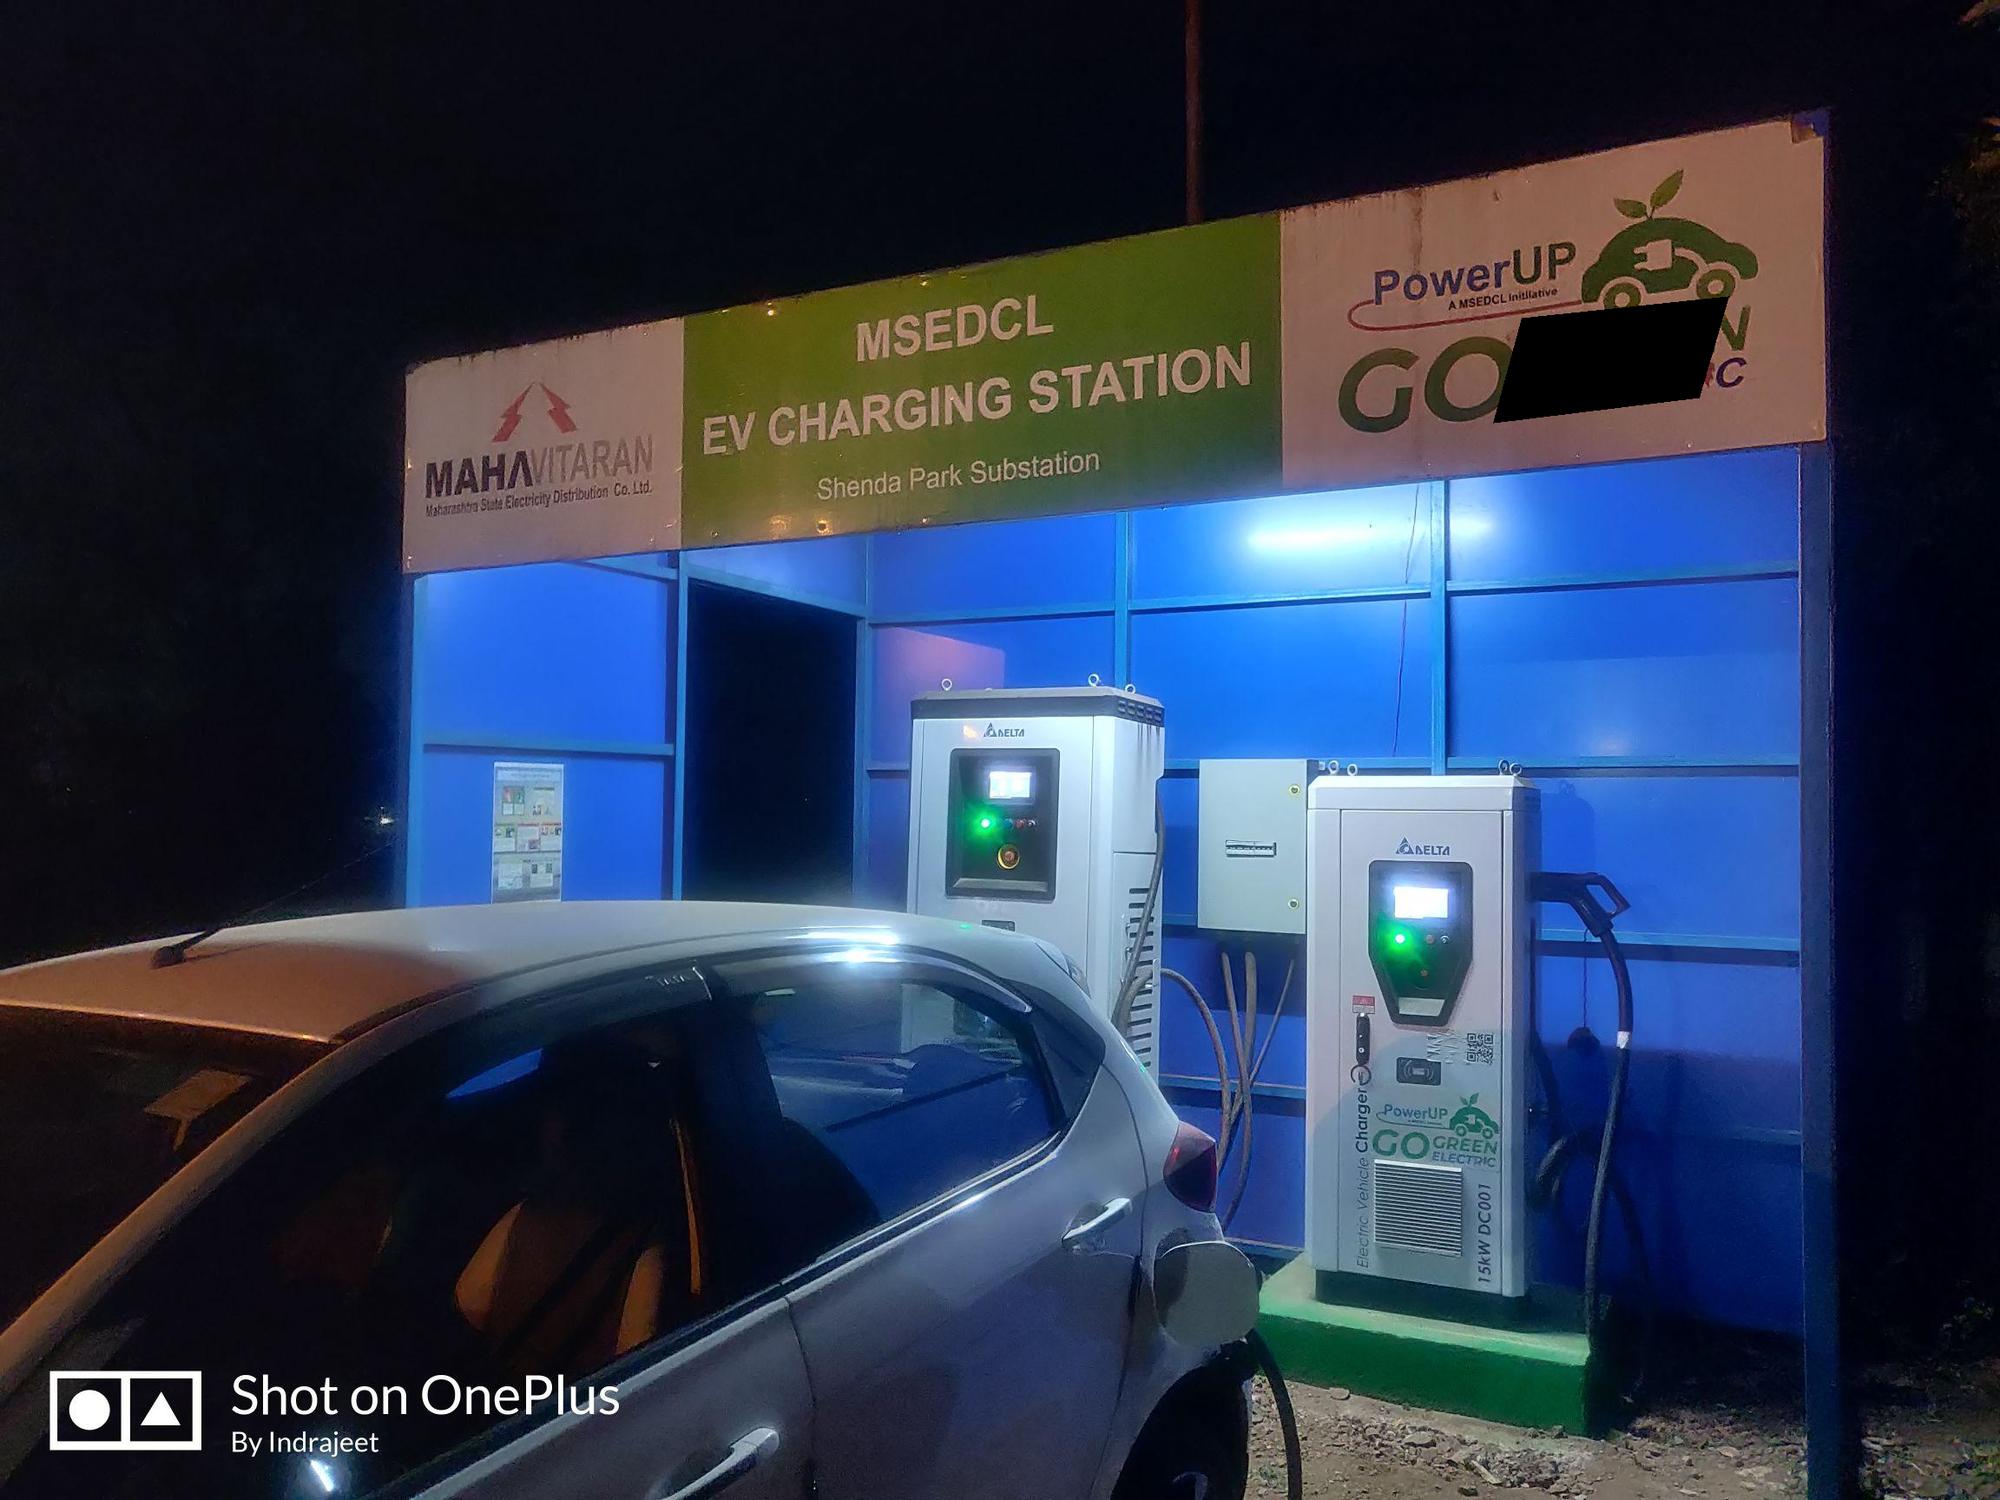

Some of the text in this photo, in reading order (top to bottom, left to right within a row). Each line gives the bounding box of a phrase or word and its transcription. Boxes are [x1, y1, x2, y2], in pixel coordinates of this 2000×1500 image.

[1374, 241, 1577, 305] PowerUP
[1448, 300, 1457, 311] A
[1459, 293, 1507, 309] MSEDCL
[856, 295, 1054, 362] MSEDCL
[703, 341, 1252, 455] EV CHARGING STATION
[425, 434, 653, 498] MAHAVITARAN
[817, 451, 1100, 501] Shenda Park Substation
[425, 480, 653, 517] Maharashtra State Electricity Distribution Co. Ltd.
[998, 728, 1025, 738] DELTA
[1415, 845, 1450, 856] DELTA
[1384, 1104, 1448, 1119] PowerUP
[1372, 1129, 1498, 1159] GO GREEN
[1431, 1151, 1497, 1168] ELECTRIC
[1355, 1087, 1371, 1269] Electric Vehicle Charger
[1477, 1183, 1491, 1284] 15kW DC001
